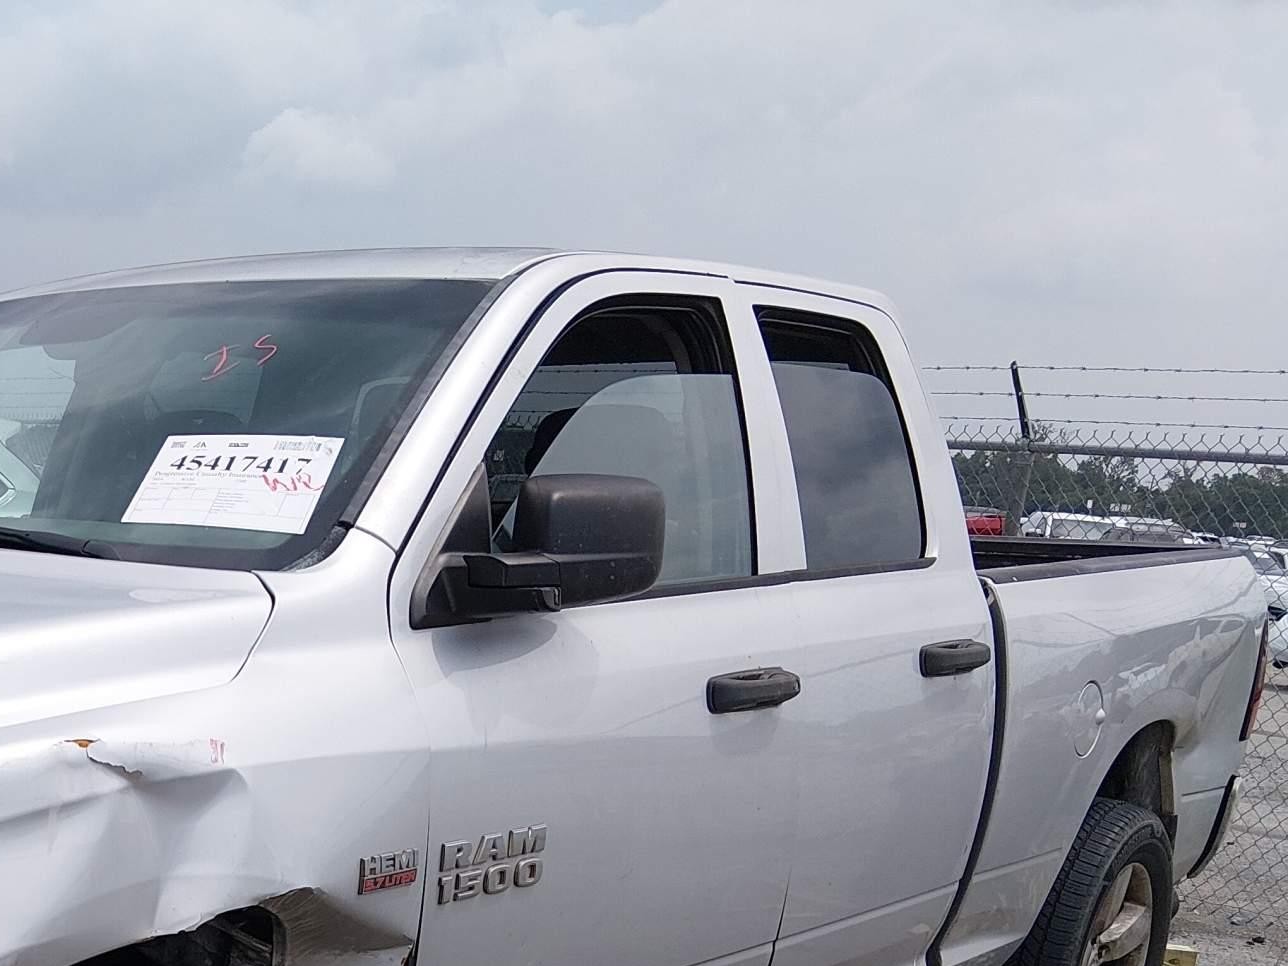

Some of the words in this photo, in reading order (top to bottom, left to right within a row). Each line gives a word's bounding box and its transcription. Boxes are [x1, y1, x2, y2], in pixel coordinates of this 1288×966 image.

[169, 454, 313, 475] 45417417
[359, 848, 419, 878] HEMI
[439, 823, 547, 872] RAM
[437, 856, 544, 905] 1500
